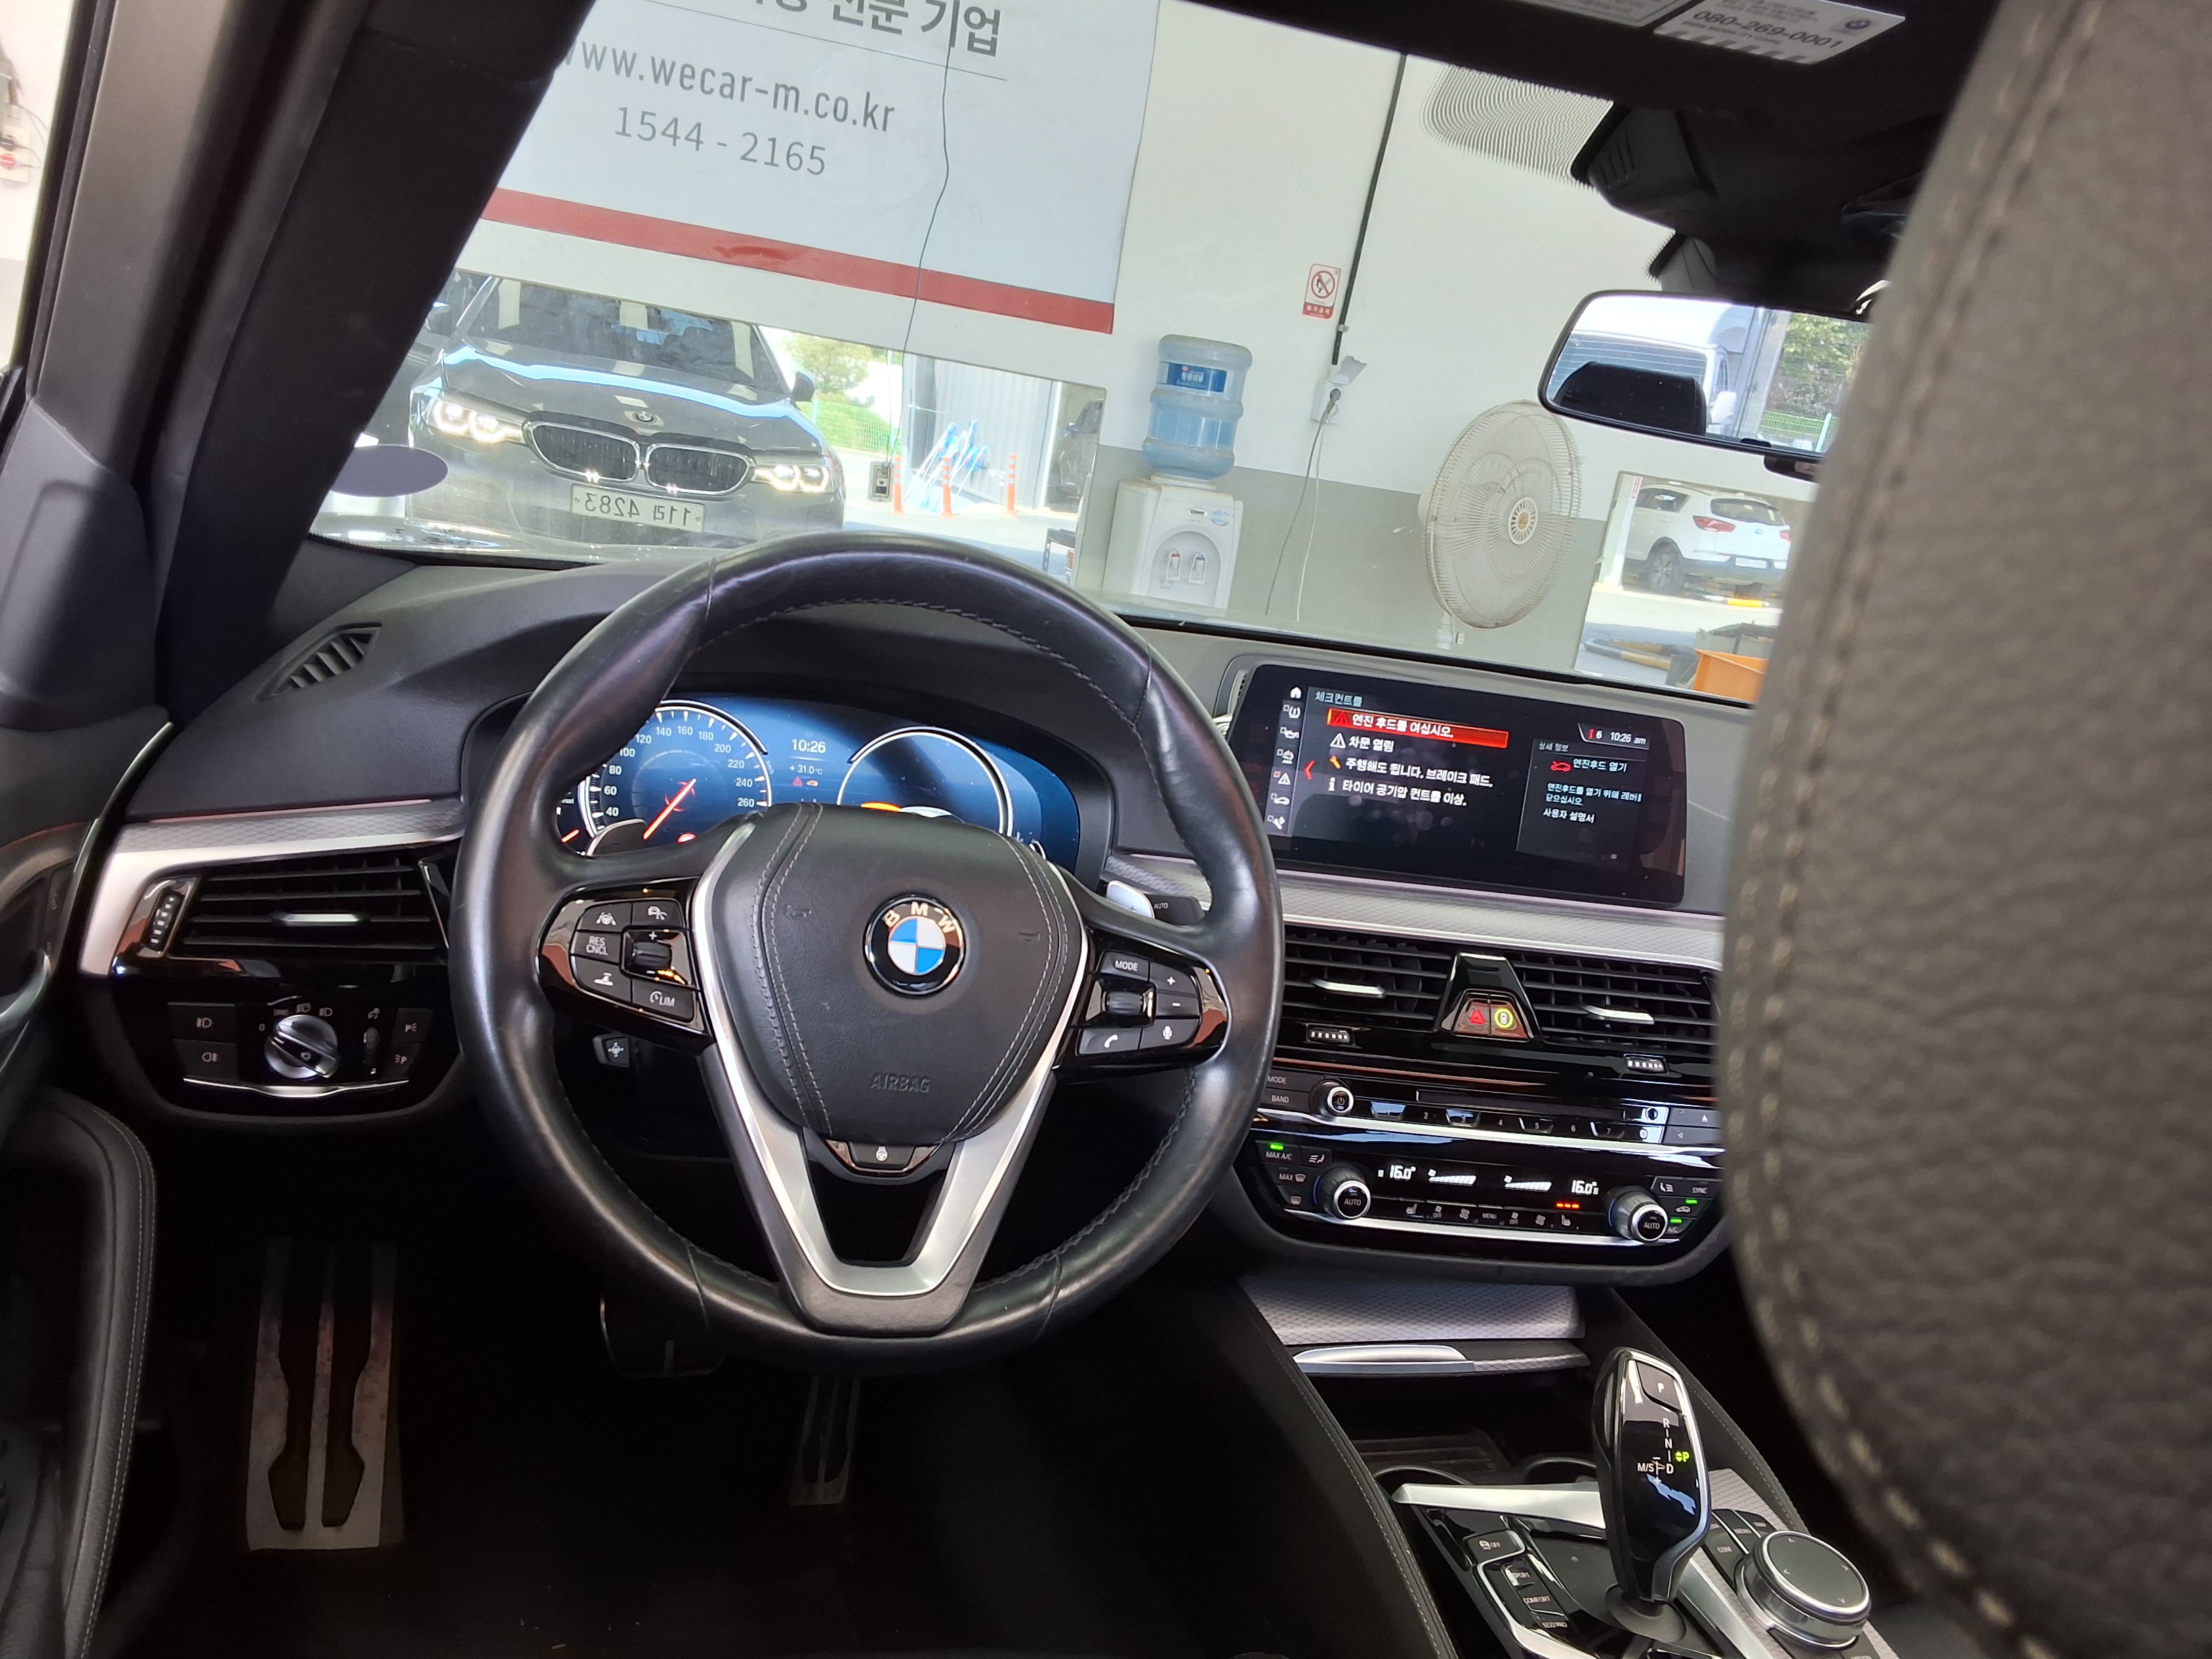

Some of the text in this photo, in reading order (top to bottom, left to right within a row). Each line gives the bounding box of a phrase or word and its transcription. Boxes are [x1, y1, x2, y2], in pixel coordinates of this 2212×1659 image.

[920, 0, 1002, 57] 기업
[1692, 9, 1845, 49] 080-269-0001
[565, 39, 895, 132] ww.wecar-m.co.kr
[615, 106, 704, 151] 1544
[739, 131, 826, 176] 2165
[1307, 305, 1330, 314] 화기금지
[677, 724, 693, 735] 160
[1352, 713, 1454, 738] 엔진 후드를 여십시오.
[655, 726, 671, 737] 140
[698, 730, 714, 741] 180
[1596, 730, 1603, 739] 6
[1610, 731, 1631, 743] 10:26
[635, 733, 651, 744] 120
[1349, 735, 1394, 752] 차문 열림
[714, 743, 731, 753] 200
[792, 738, 826, 753] 10:26
[1538, 741, 1569, 752] 상세 정보
[619, 746, 635, 757] 100
[727, 758, 744, 769] 220
[1572, 758, 1627, 773] 엔진후드 열기
[609, 764, 621, 775] 80
[1345, 758, 1493, 787] 주행해도 됩니다. 브레이크 패드.
[736, 777, 752, 787] 240
[604, 785, 617, 796] 60
[1342, 779, 1467, 806] 타이어 공기압 컨트롤 이상.
[1586, 787, 1601, 796] 열기
[737, 796, 754, 807] 260
[606, 806, 619, 817] 40
[1542, 807, 1595, 823] 사용자 설명서
[883, 901, 956, 934] BMW
[588, 935, 605, 945] RES
[586, 945, 608, 956] CNCL
[1114, 959, 1138, 971] MODE
[659, 995, 675, 1007] LIM
[870, 1072, 932, 1093] AIRBAG
[1267, 1075, 1286, 1084] MODE
[1271, 1094, 1289, 1103] BAND
[1423, 1111, 1428, 1120] 2
[1460, 1114, 1465, 1123] 3
[1265, 1150, 1292, 1160] MAX A/C
[1278, 1172, 1293, 1181] MAX
[1692, 1185, 1707, 1195] SYNC
[1344, 1197, 1361, 1207] AUTO
[1643, 1221, 1660, 1230] AUTO
[1667, 1225, 1678, 1233] A/C
[1657, 1382, 1664, 1393] P
[1662, 1417, 1670, 1428] R
[1664, 1437, 1672, 1448] N
[1637, 1462, 1673, 1474] M/S D
[1717, 1545, 1732, 1553] COM
[1523, 1595, 1551, 1603] COMFORT
